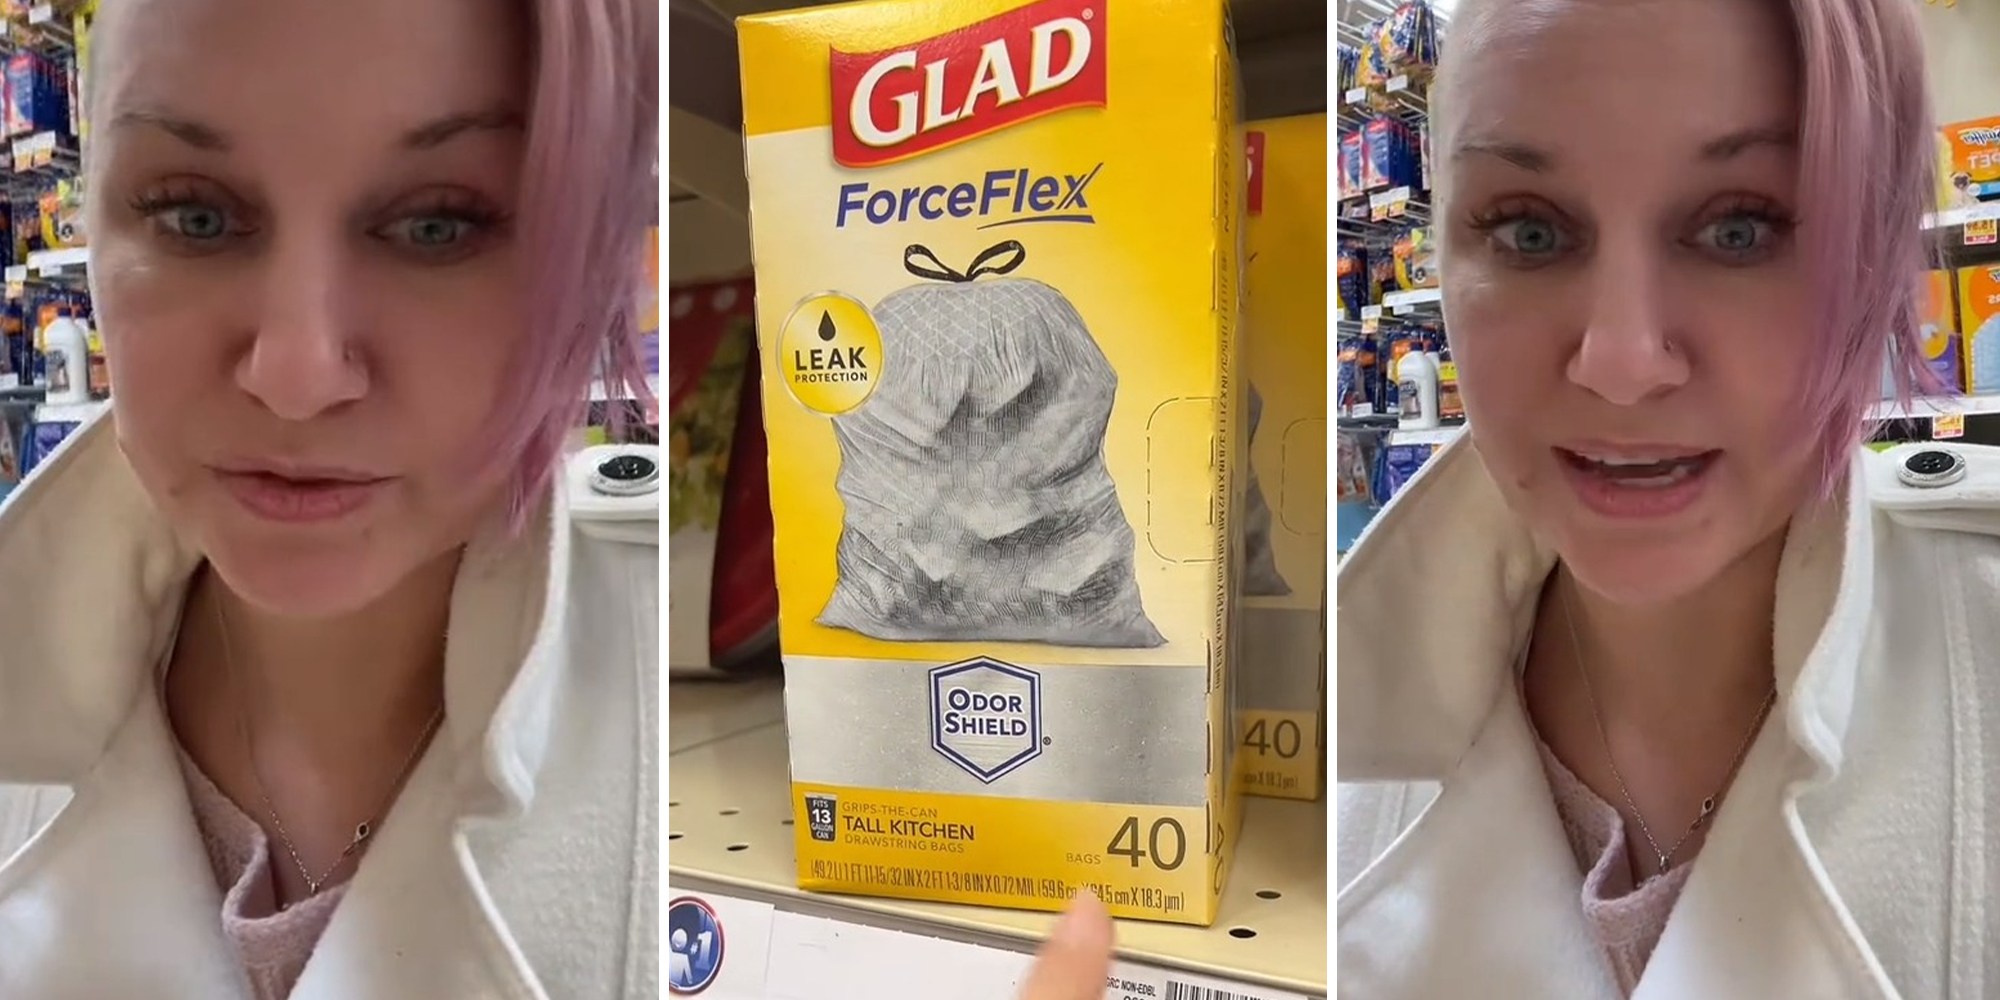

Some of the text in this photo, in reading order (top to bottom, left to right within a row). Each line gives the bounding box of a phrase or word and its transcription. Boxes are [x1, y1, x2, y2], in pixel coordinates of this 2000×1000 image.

[850, 17, 1092, 147] GLAD
[836, 163, 1104, 228] ForceFlex
[795, 346, 867, 371] LEAK
[795, 371, 868, 383] PROTECTION
[948, 688, 1023, 713] ODOR
[945, 712, 1027, 736] SHIELD
[1242, 719, 1301, 759] 40
[812, 809, 831, 824] 13
[842, 801, 938, 819] GRIPS-THE-CAN
[842, 815, 975, 841] TALL KITCHEN
[844, 834, 965, 854] DRAWSTRING BAGS
[1107, 816, 1186, 871] 40
[1066, 852, 1101, 865] BAGS
